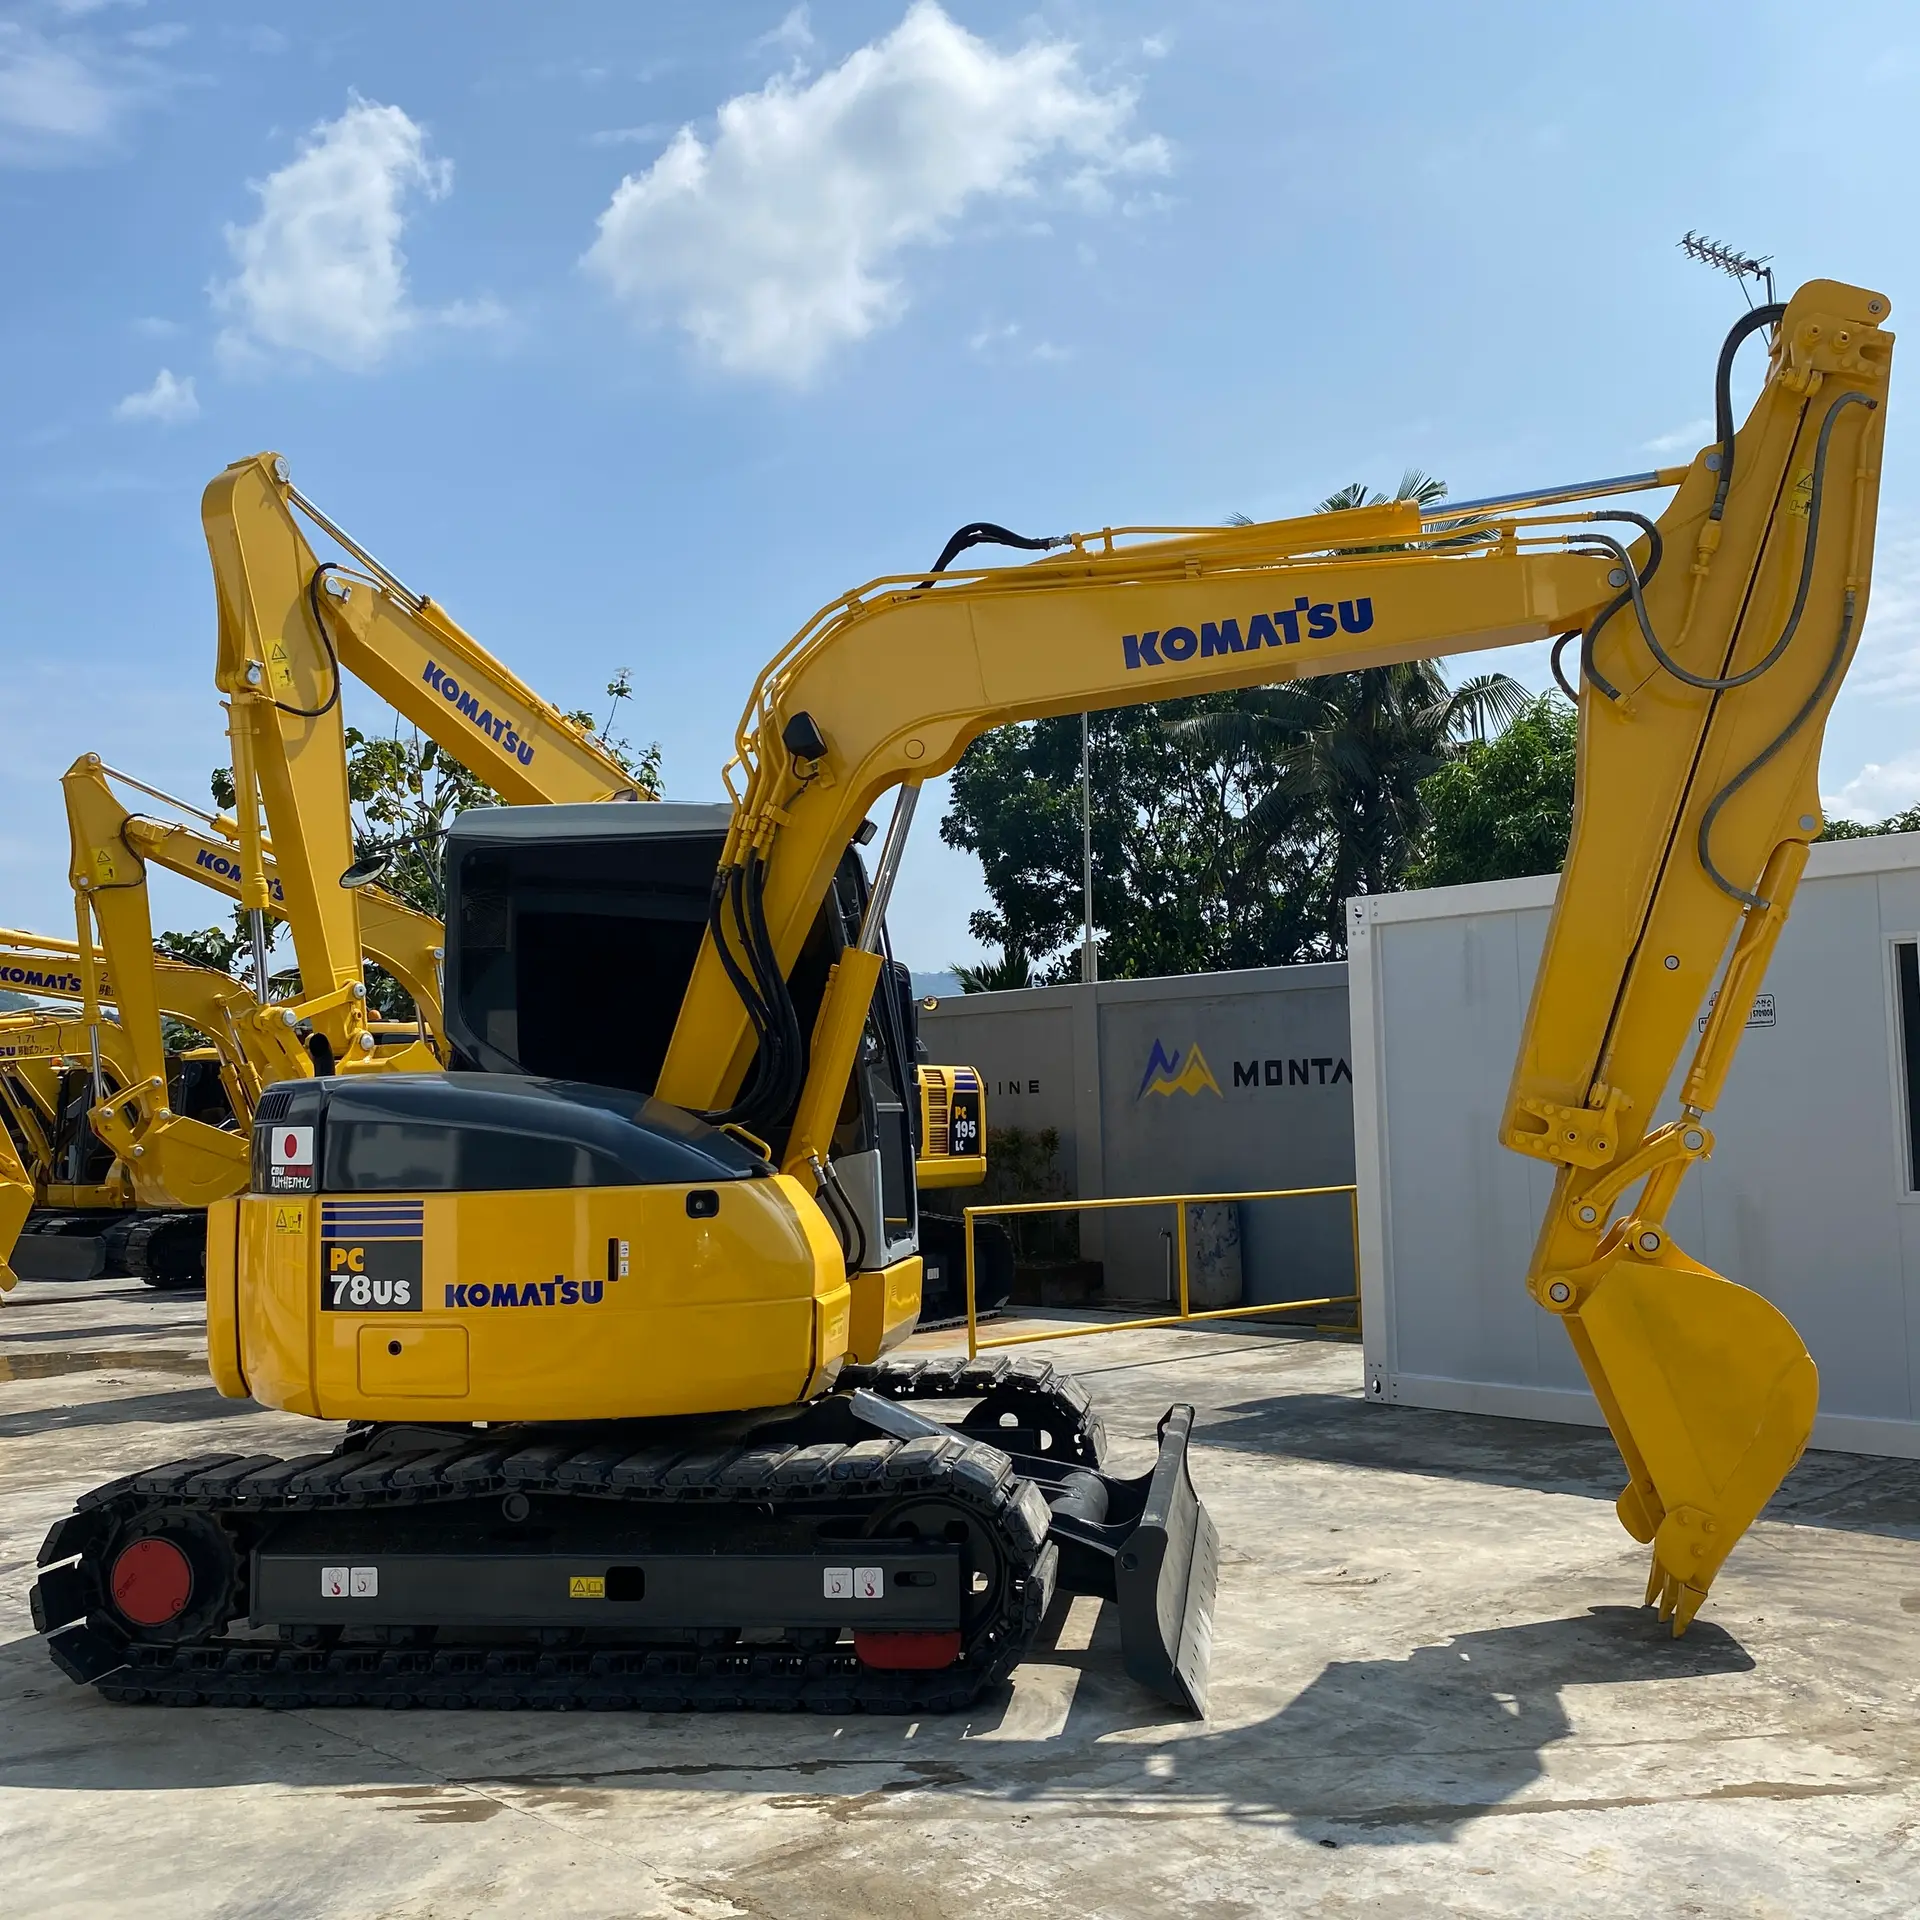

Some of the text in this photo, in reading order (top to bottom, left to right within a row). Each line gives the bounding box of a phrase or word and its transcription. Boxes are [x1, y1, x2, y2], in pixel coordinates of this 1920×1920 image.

[1122, 597, 1374, 669] KOMATSU
[422, 660, 535, 765] KOMATSU
[1233, 1057, 1353, 1087] MONTA
[955, 1106, 967, 1119] PC
[955, 1121, 976, 1138] 195
[955, 1140, 964, 1151] LC
[330, 1247, 365, 1272] PC
[330, 1275, 411, 1305] 78US
[445, 1275, 604, 1308] KOMATSU
